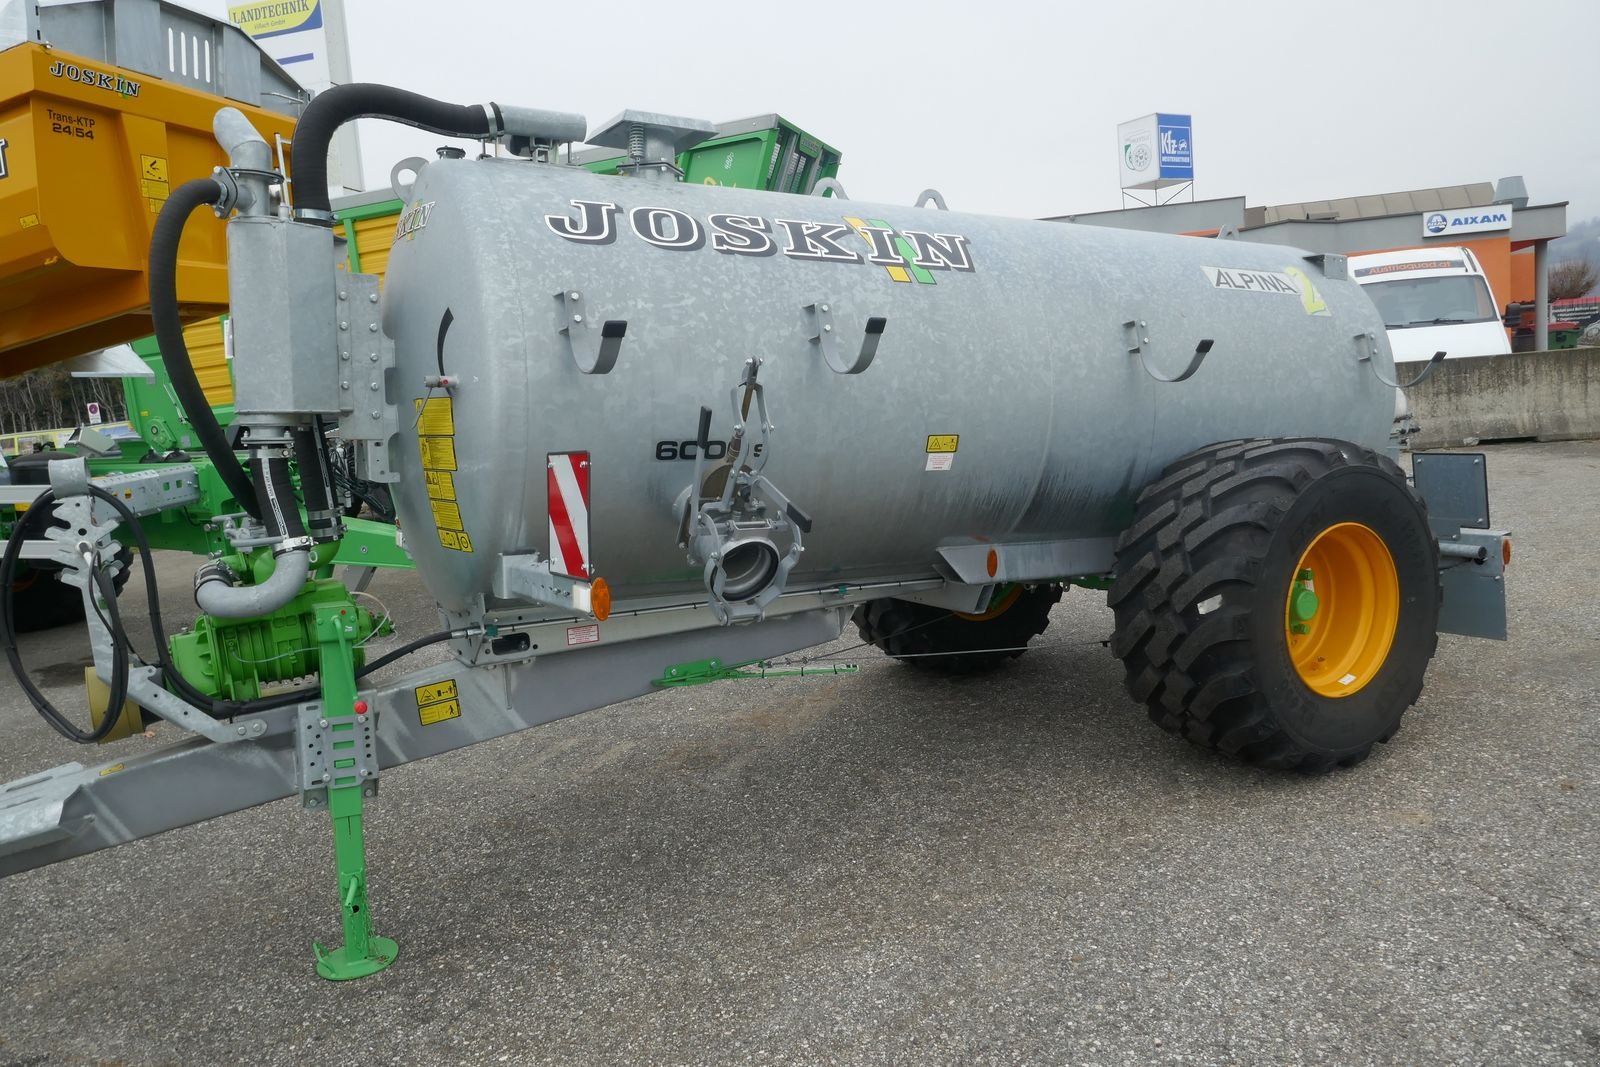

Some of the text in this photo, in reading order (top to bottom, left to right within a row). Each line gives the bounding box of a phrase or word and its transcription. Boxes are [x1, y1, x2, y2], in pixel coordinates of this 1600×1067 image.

[233, 0, 309, 24] LANDTECHNIK
[50, 61, 140, 97] JOSKIN
[47, 109, 95, 128] Trans-KTP
[1451, 214, 1507, 226] AIXAM
[544, 199, 976, 273] JOSKIN
[1216, 269, 1298, 294] ALPINA
[655, 440, 746, 460] 600
